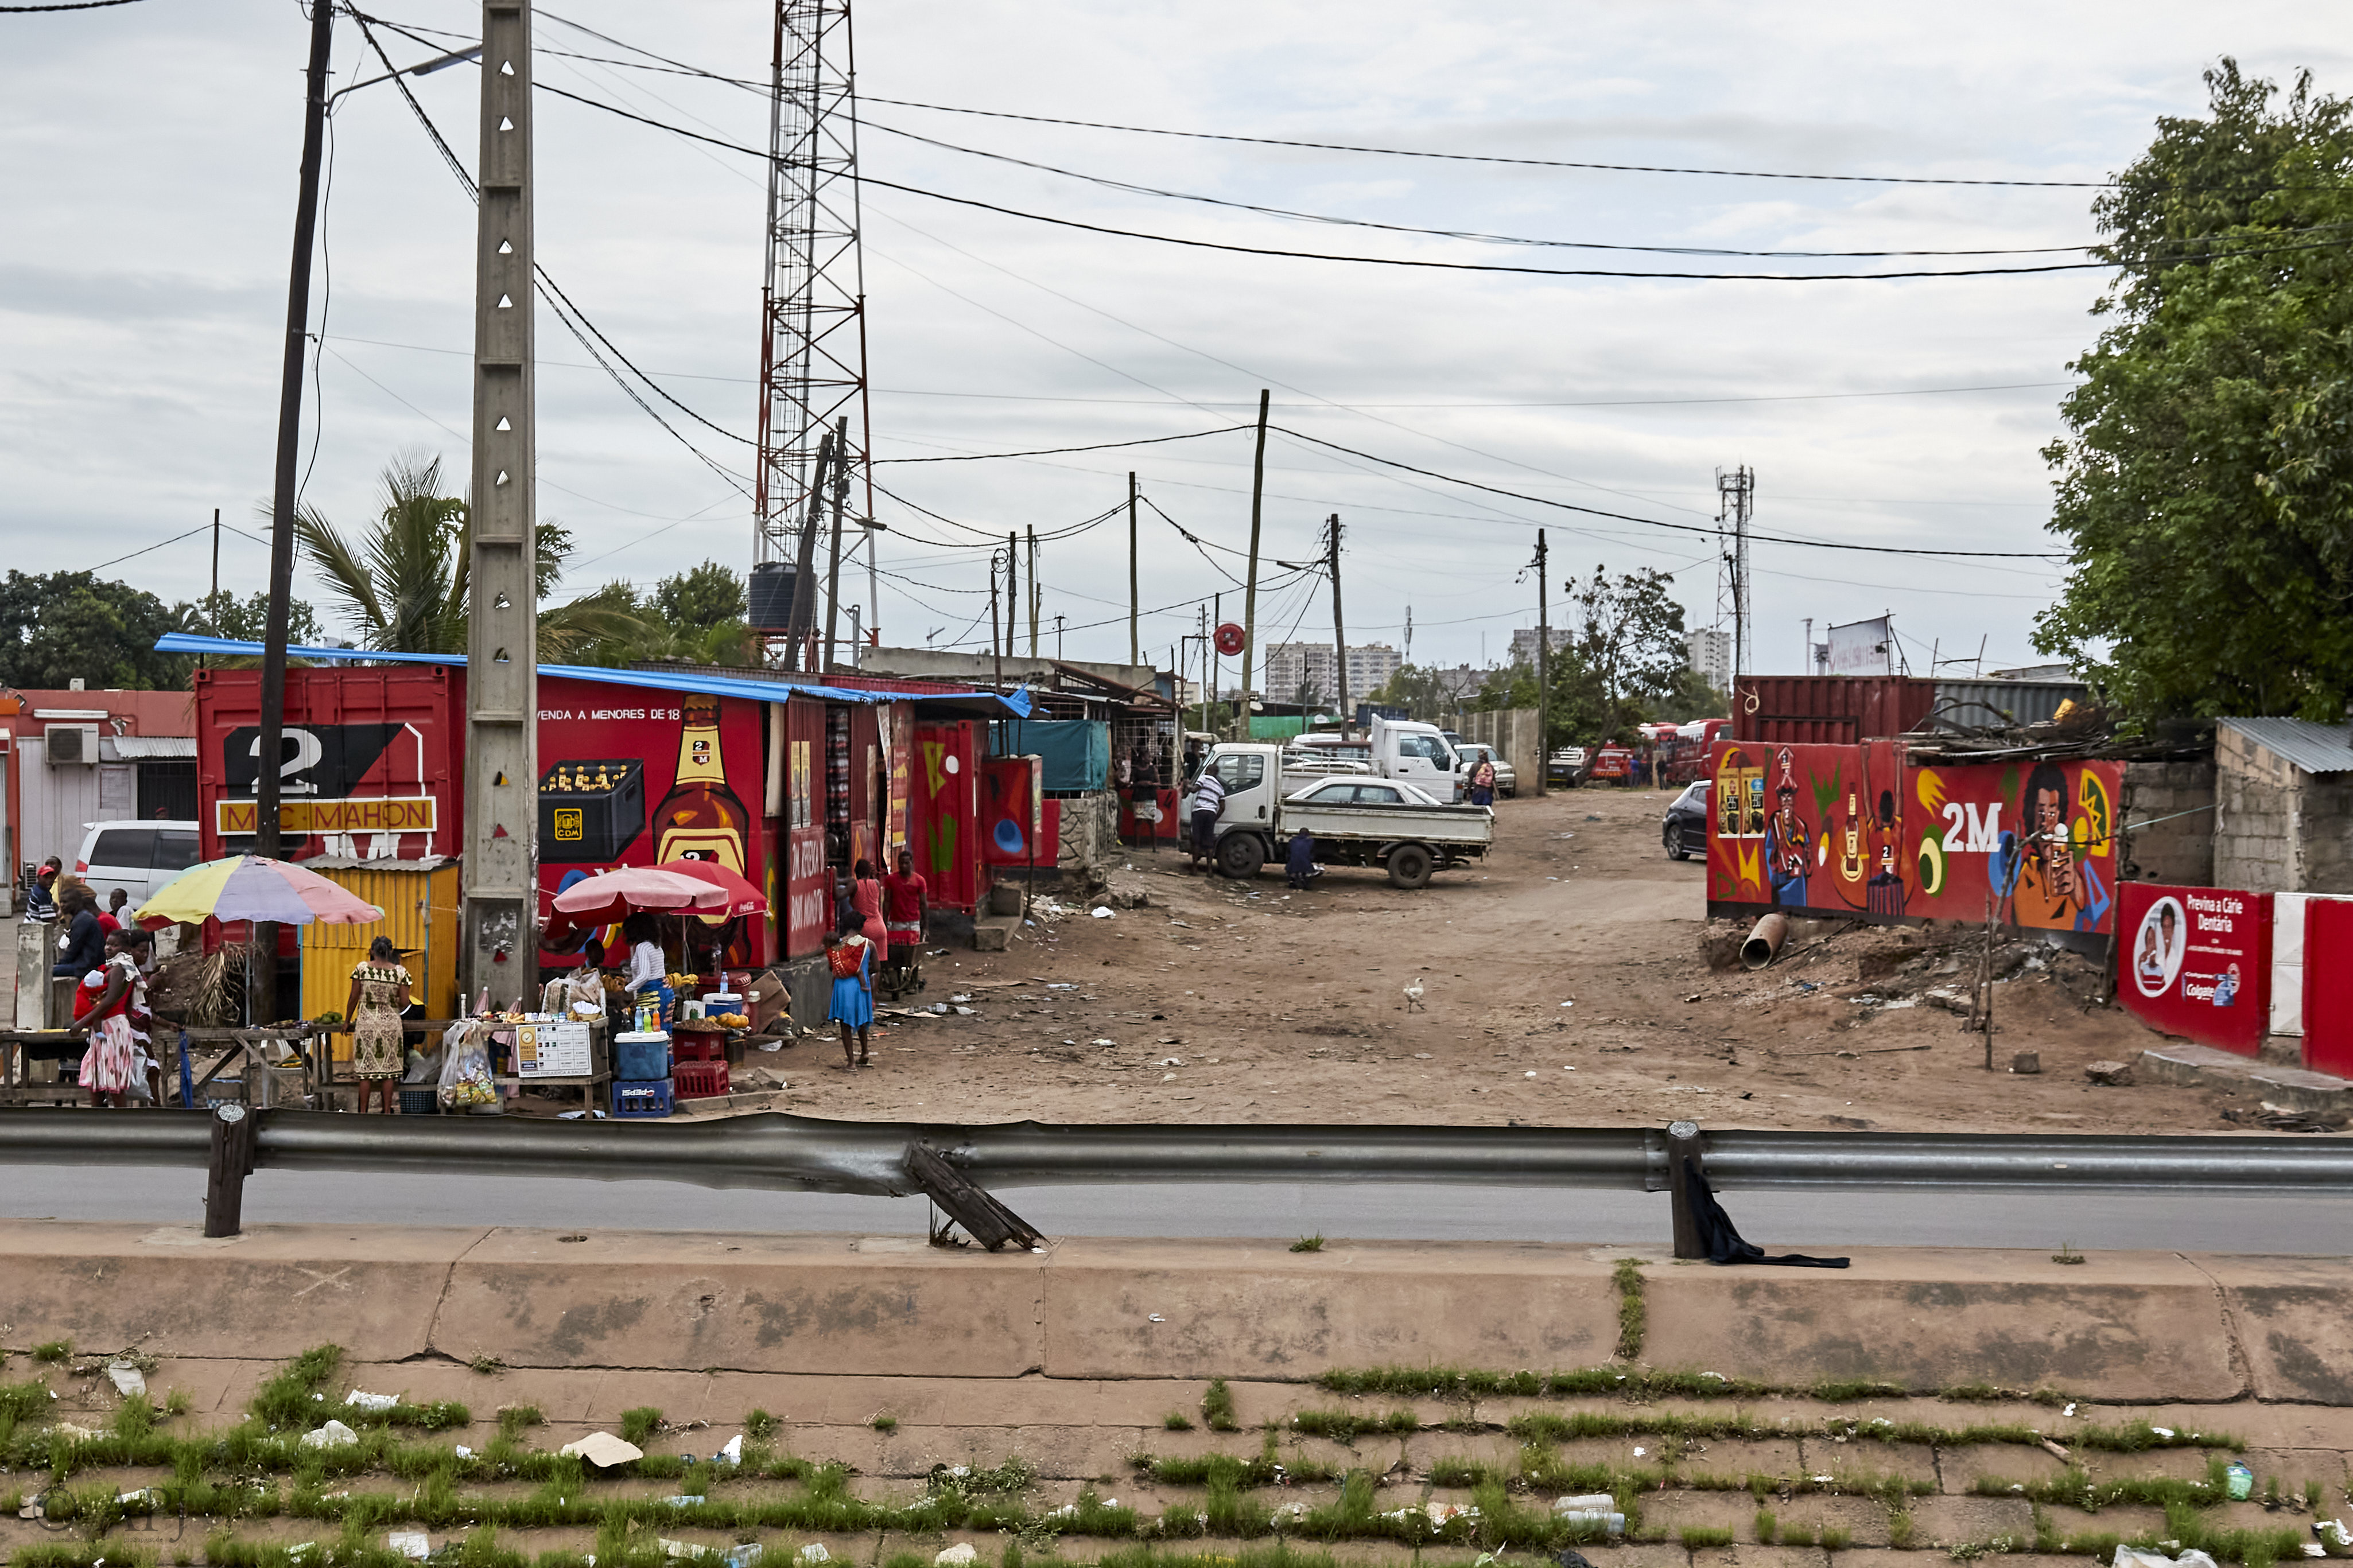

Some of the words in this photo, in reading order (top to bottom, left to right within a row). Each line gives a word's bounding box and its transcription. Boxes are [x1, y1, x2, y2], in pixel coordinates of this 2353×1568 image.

[578, 710, 586, 719] A
[591, 709, 645, 719] MENORES
[651, 709, 665, 719] DE
[667, 709, 680, 720] 18
[695, 741, 702, 750] 2
[249, 727, 322, 794] 2
[227, 806, 294, 830] MC
[315, 803, 426, 827] MAHON
[1942, 803, 2003, 853] 2M
[1883, 846, 1889, 858] 2
[2187, 894, 2215, 912] Previna
[2216, 901, 2221, 912] a
[2223, 897, 2243, 914] Cárie
[2198, 913, 2232, 932] Dentária
[2187, 984, 2214, 999] Colgate
